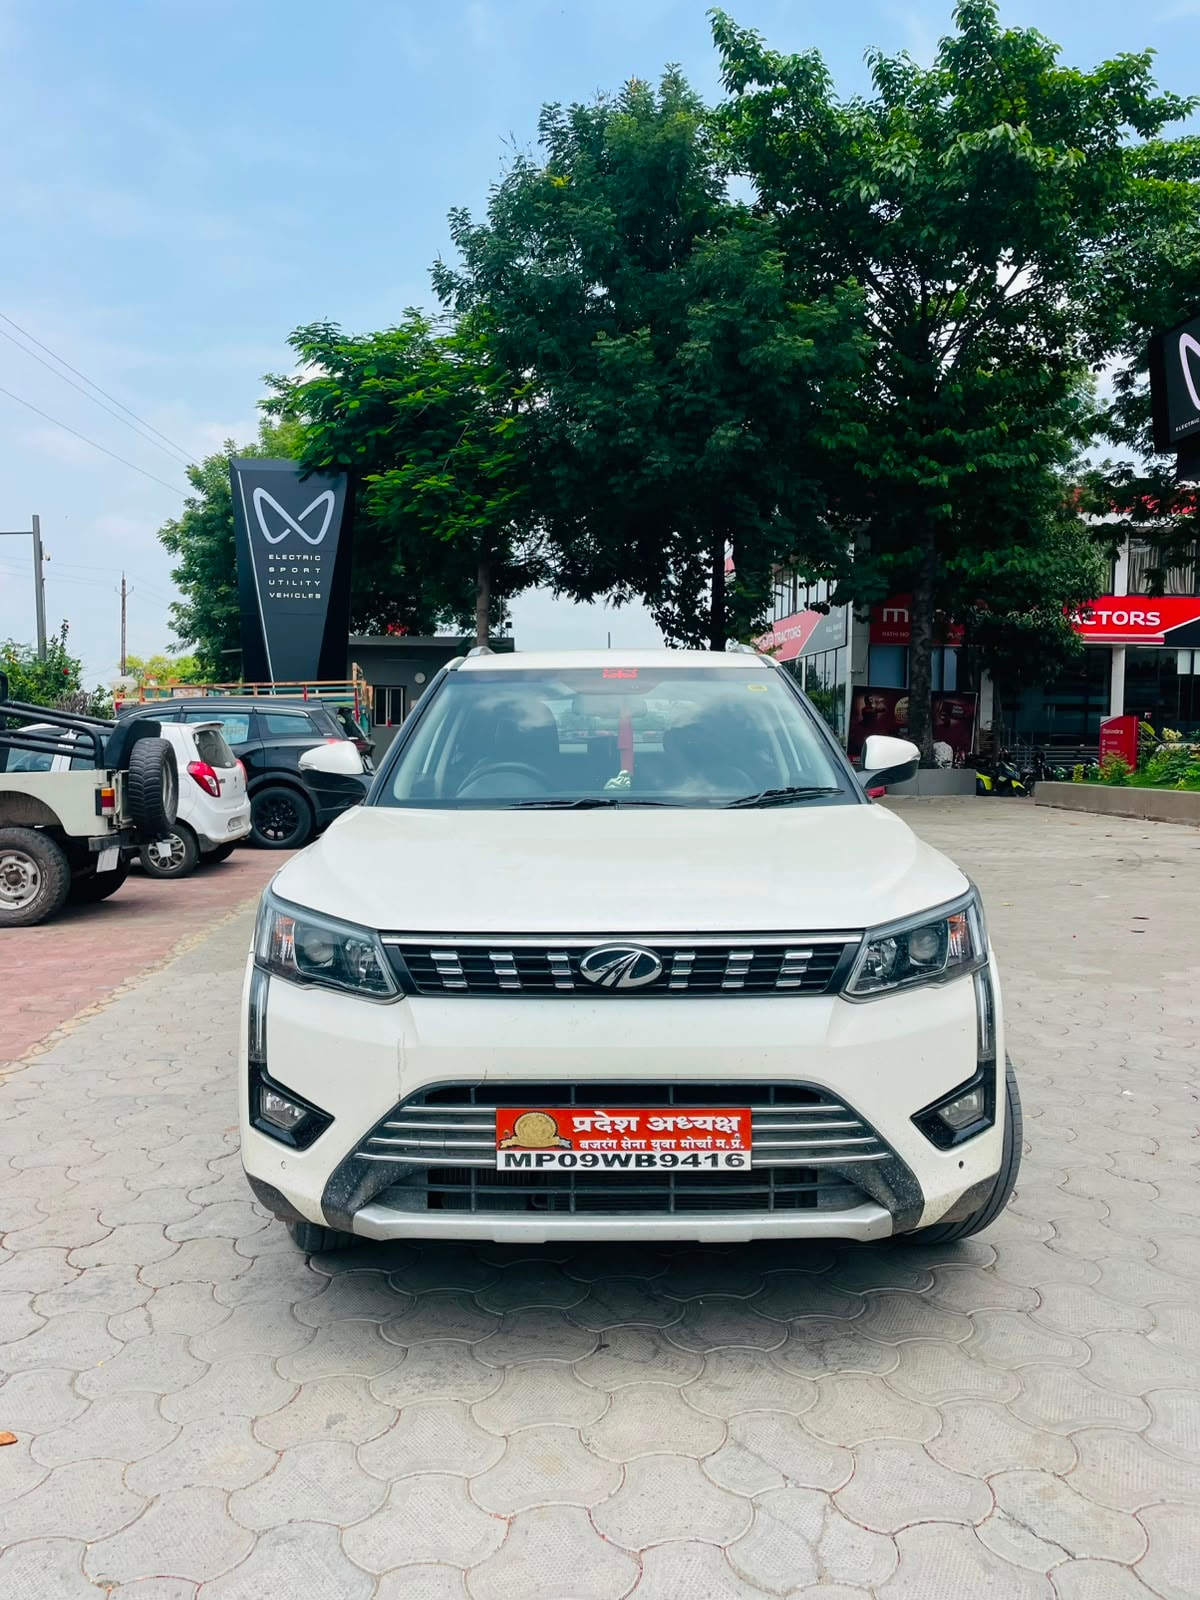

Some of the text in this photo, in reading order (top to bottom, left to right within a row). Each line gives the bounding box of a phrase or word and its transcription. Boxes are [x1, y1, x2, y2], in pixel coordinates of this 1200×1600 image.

[1070, 611, 1161, 626] ACTORS
[572, 1111, 741, 1133] प्रदेश अध्यक्ष
[579, 1138, 618, 1150] बजरंग
[620, 1136, 646, 1150] सेना
[650, 1139, 677, 1152] युवा
[504, 1153, 745, 1168] MP09WB9416
